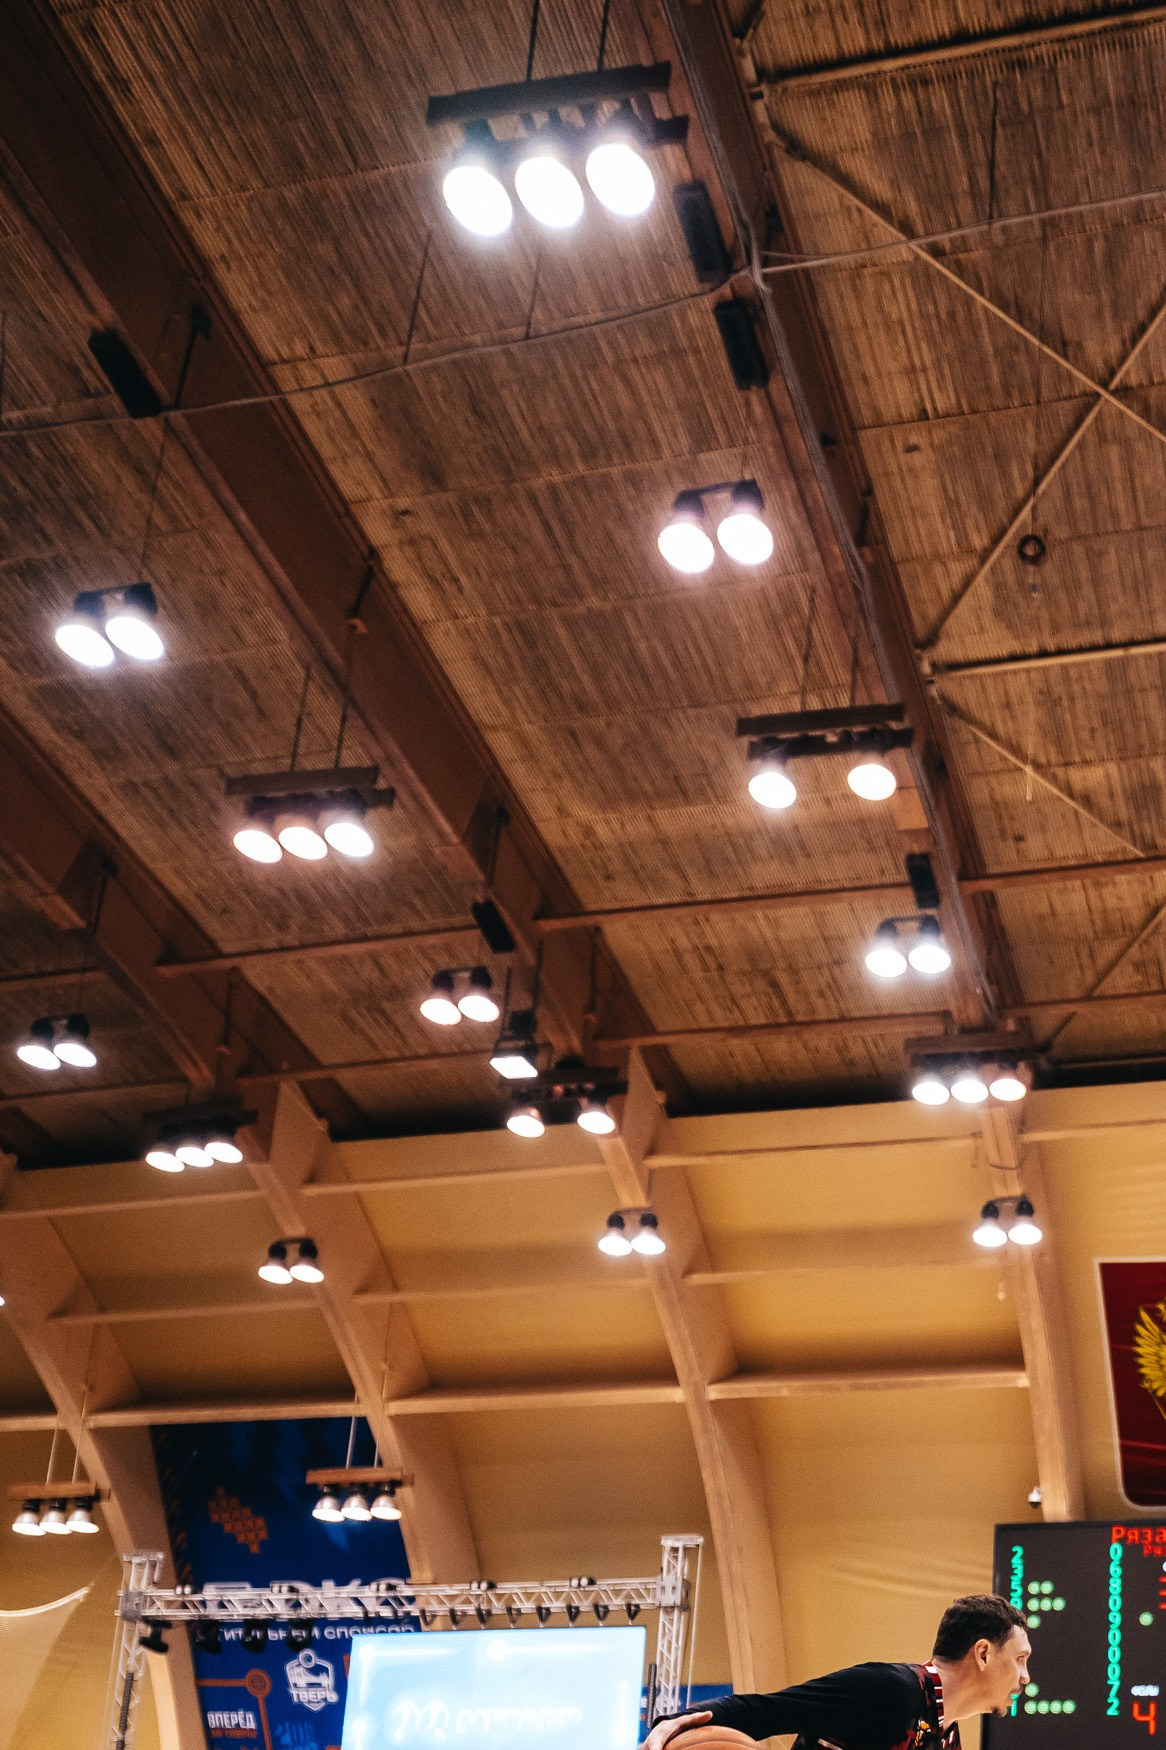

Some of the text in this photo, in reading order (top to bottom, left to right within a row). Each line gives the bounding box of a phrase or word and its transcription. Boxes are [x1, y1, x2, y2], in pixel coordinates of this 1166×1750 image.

[290, 1688, 338, 1704] ТВЕРЬ
[207, 1710, 257, 1730] ВПЕРЁД
[1132, 1701, 1157, 1735] 4
